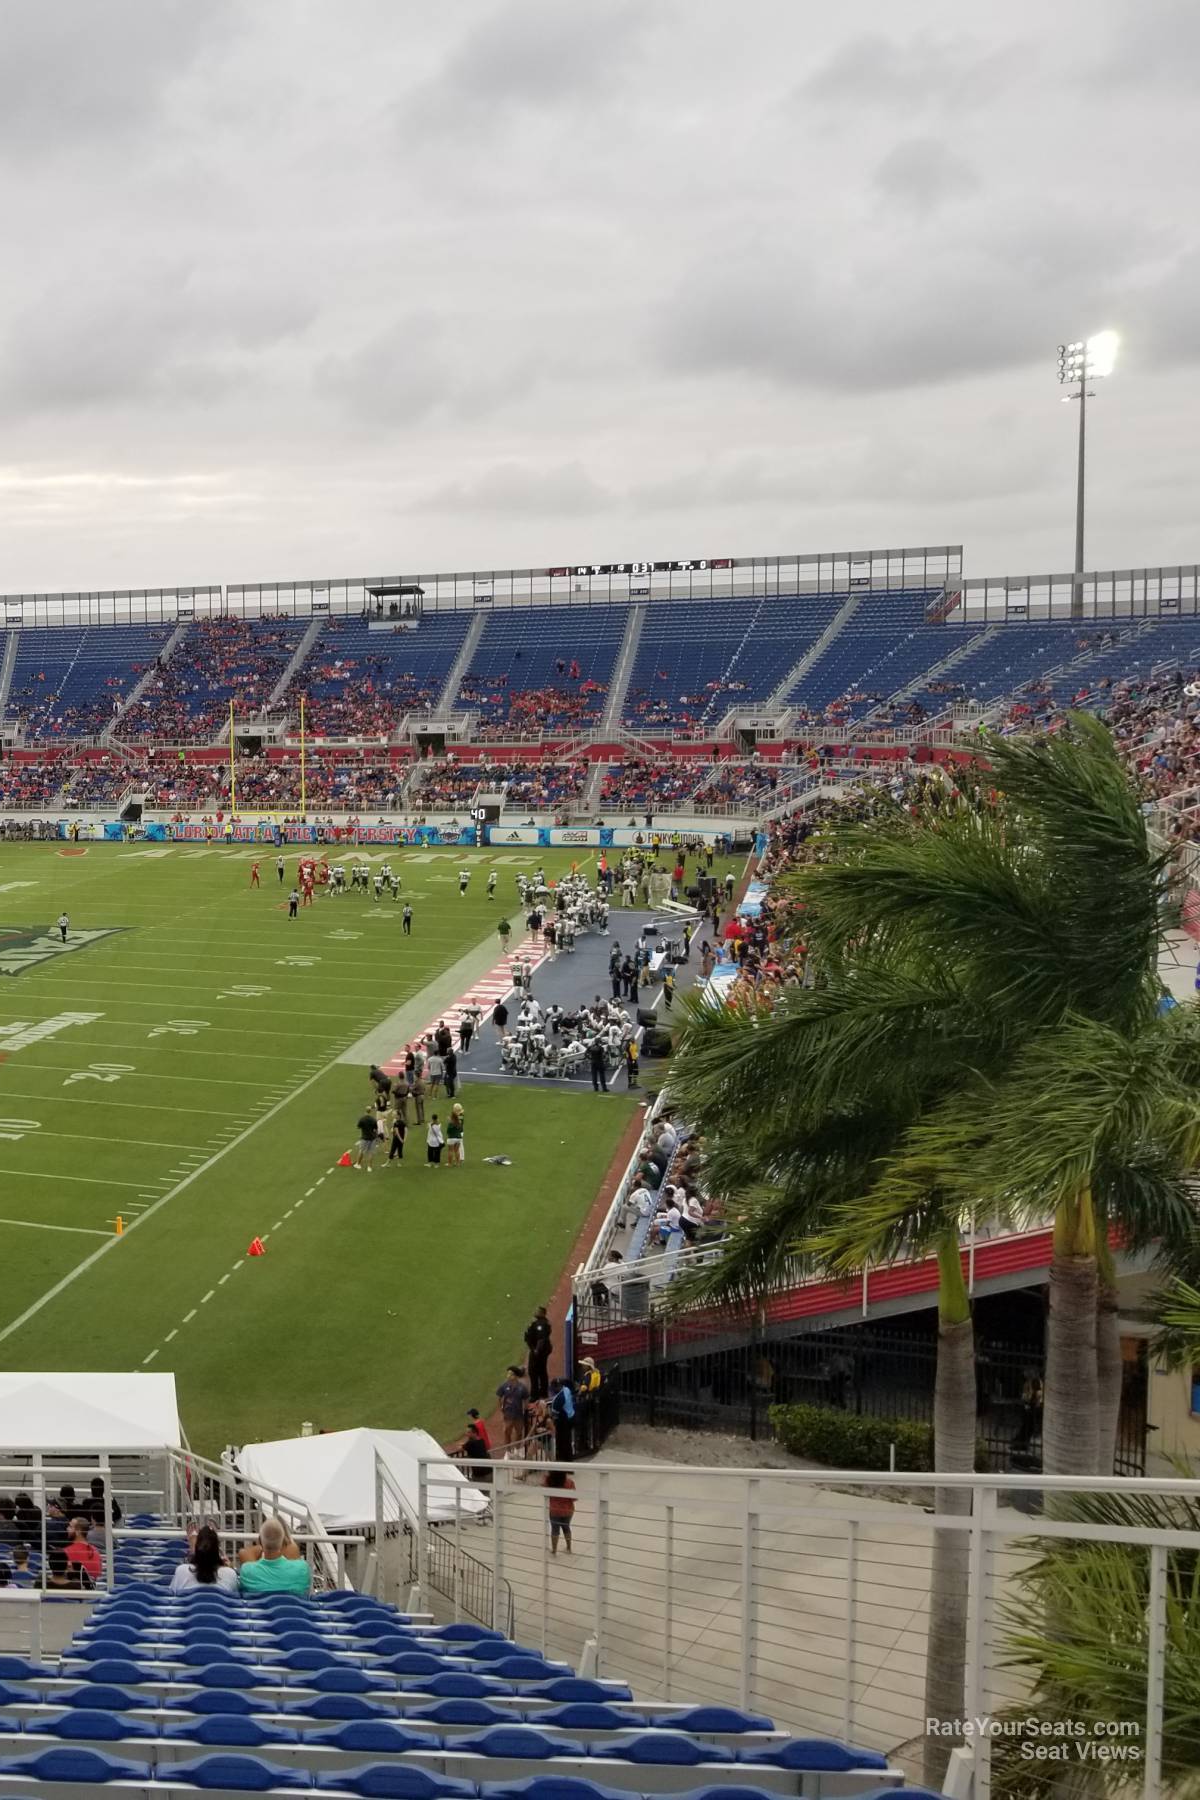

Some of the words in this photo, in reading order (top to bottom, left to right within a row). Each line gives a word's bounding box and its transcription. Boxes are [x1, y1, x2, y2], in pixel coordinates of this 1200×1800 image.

[471, 808, 486, 820] 40
[117, 848, 543, 867] ATLANTIC
[222, 984, 272, 997] 40
[152, 1019, 212, 1035] 30
[69, 1062, 137, 1083] 20
